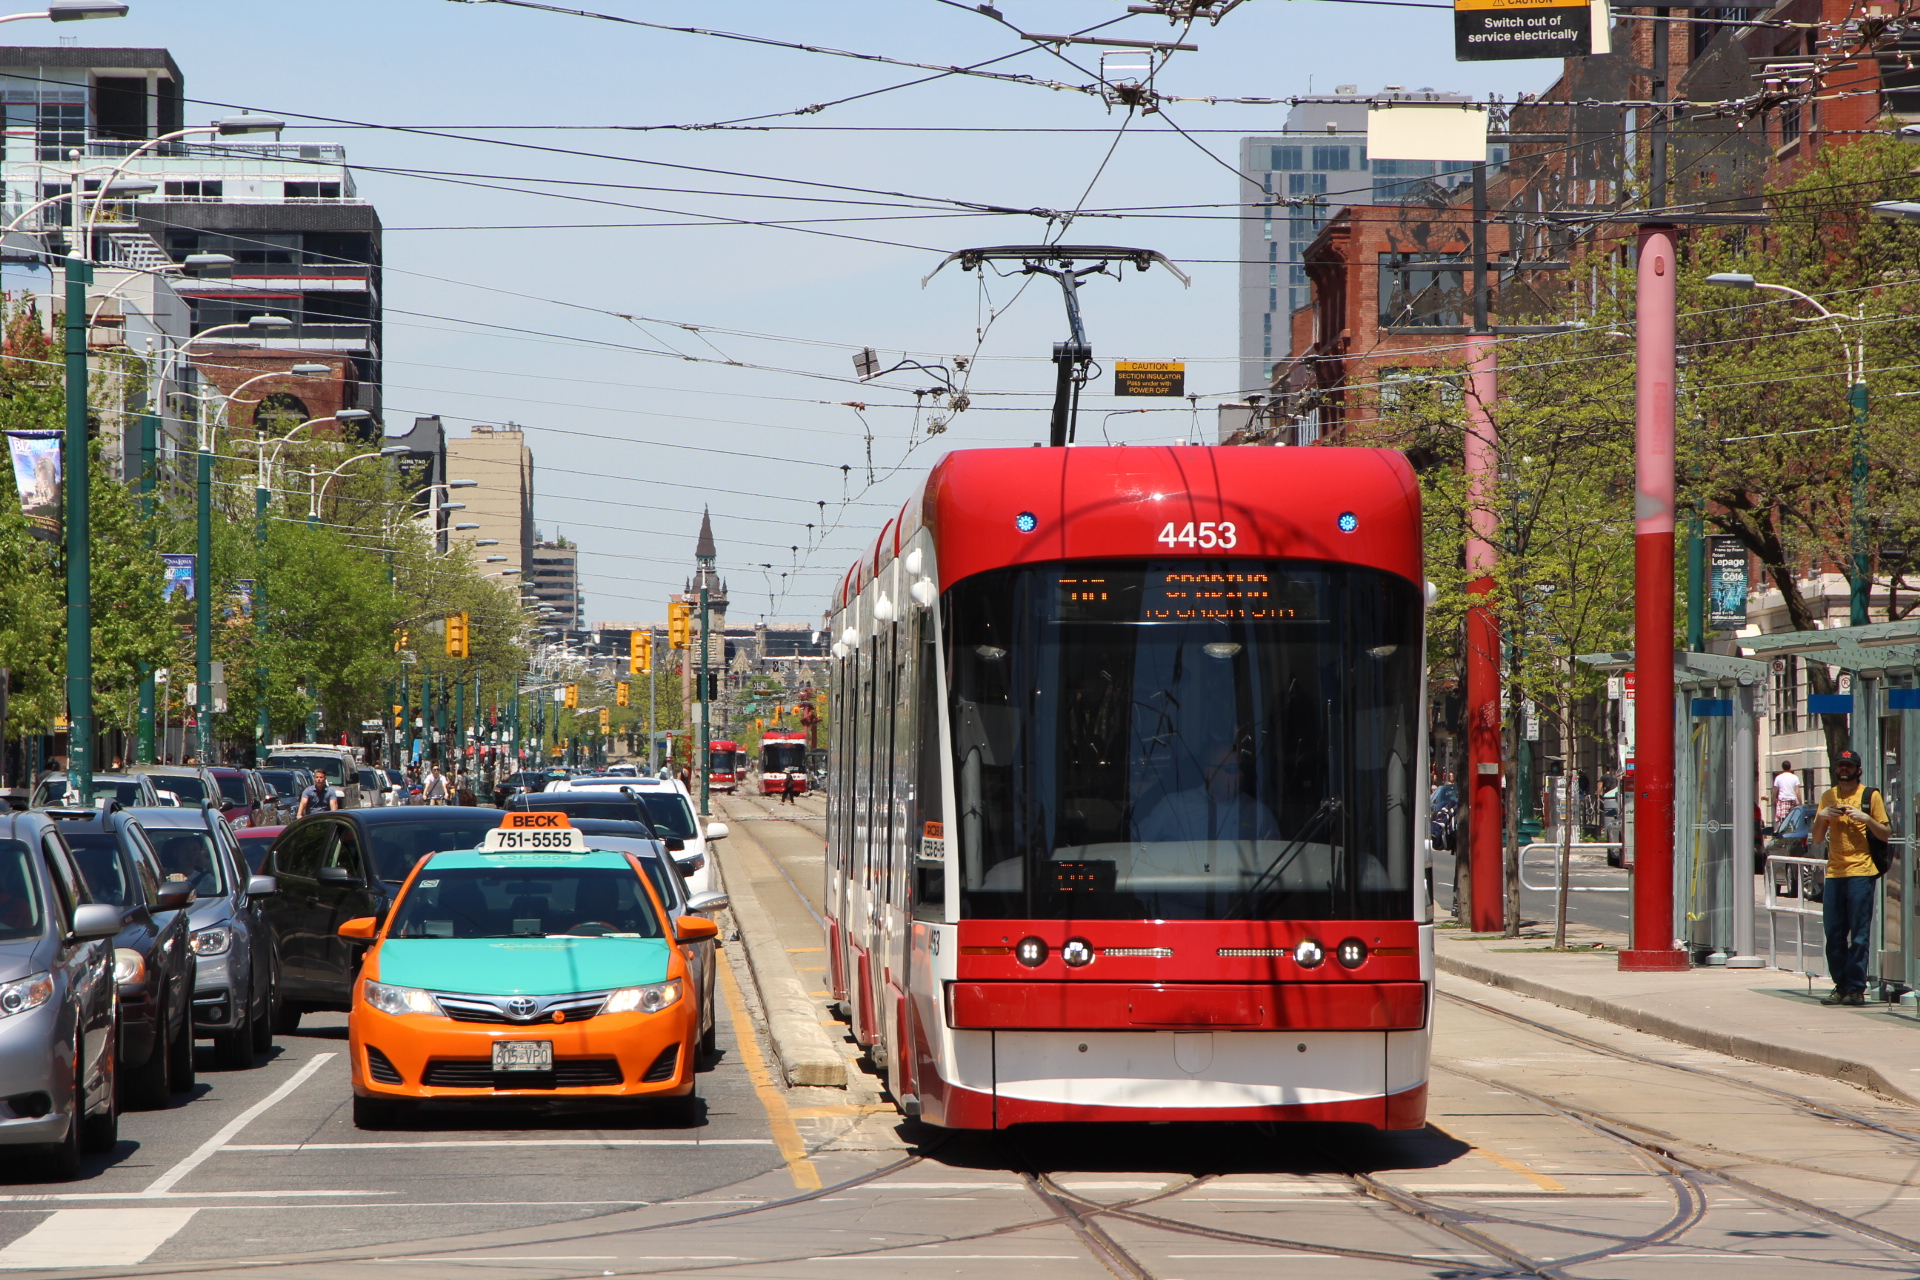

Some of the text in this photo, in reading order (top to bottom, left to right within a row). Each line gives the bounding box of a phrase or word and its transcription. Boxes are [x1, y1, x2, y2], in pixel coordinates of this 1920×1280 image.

[1484, 15, 1562, 28] Switch out of
[1468, 29, 1579, 43] service electrically
[1158, 521, 1237, 549] 4453
[1711, 558, 1745, 567] Lepage
[1722, 572, 1744, 581] Côté
[513, 815, 559, 827] BECK
[497, 832, 572, 848] 751-5555
